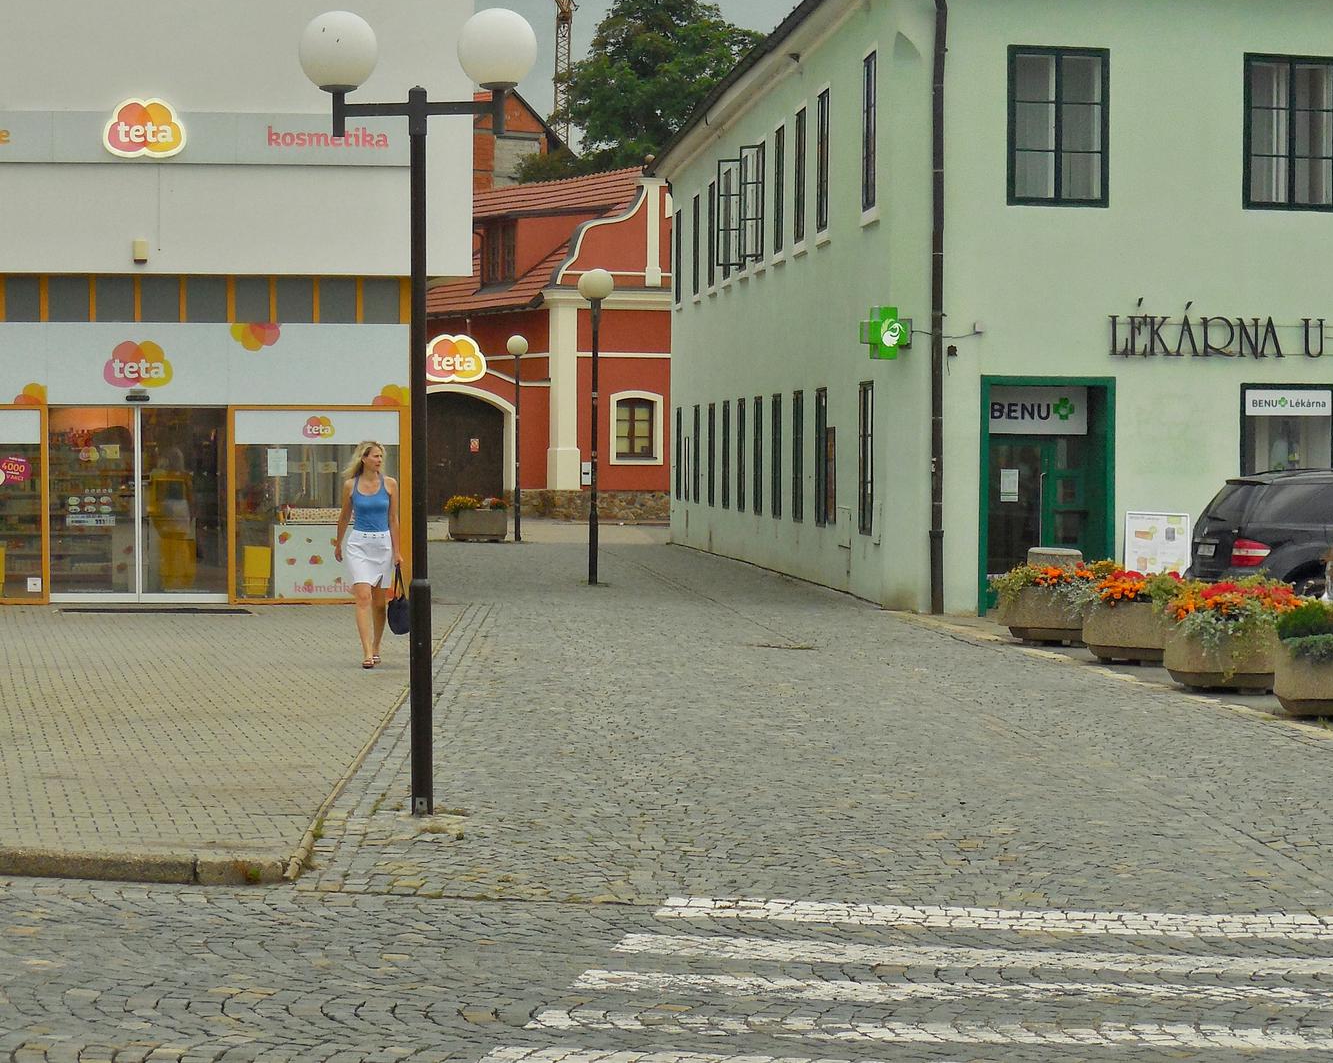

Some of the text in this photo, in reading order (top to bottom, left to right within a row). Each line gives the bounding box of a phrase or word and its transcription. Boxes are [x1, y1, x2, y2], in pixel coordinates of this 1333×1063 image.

[117, 121, 174, 143] teta
[266, 125, 389, 148] kosmetika
[1108, 297, 1286, 359] LÉKÁRNA
[1301, 318, 1326, 358] U
[112, 358, 166, 379] teta
[432, 353, 477, 371] teta
[990, 402, 1051, 421] BENU
[1252, 398, 1327, 408] BENU Lékárna
[306, 424, 331, 434] teta
